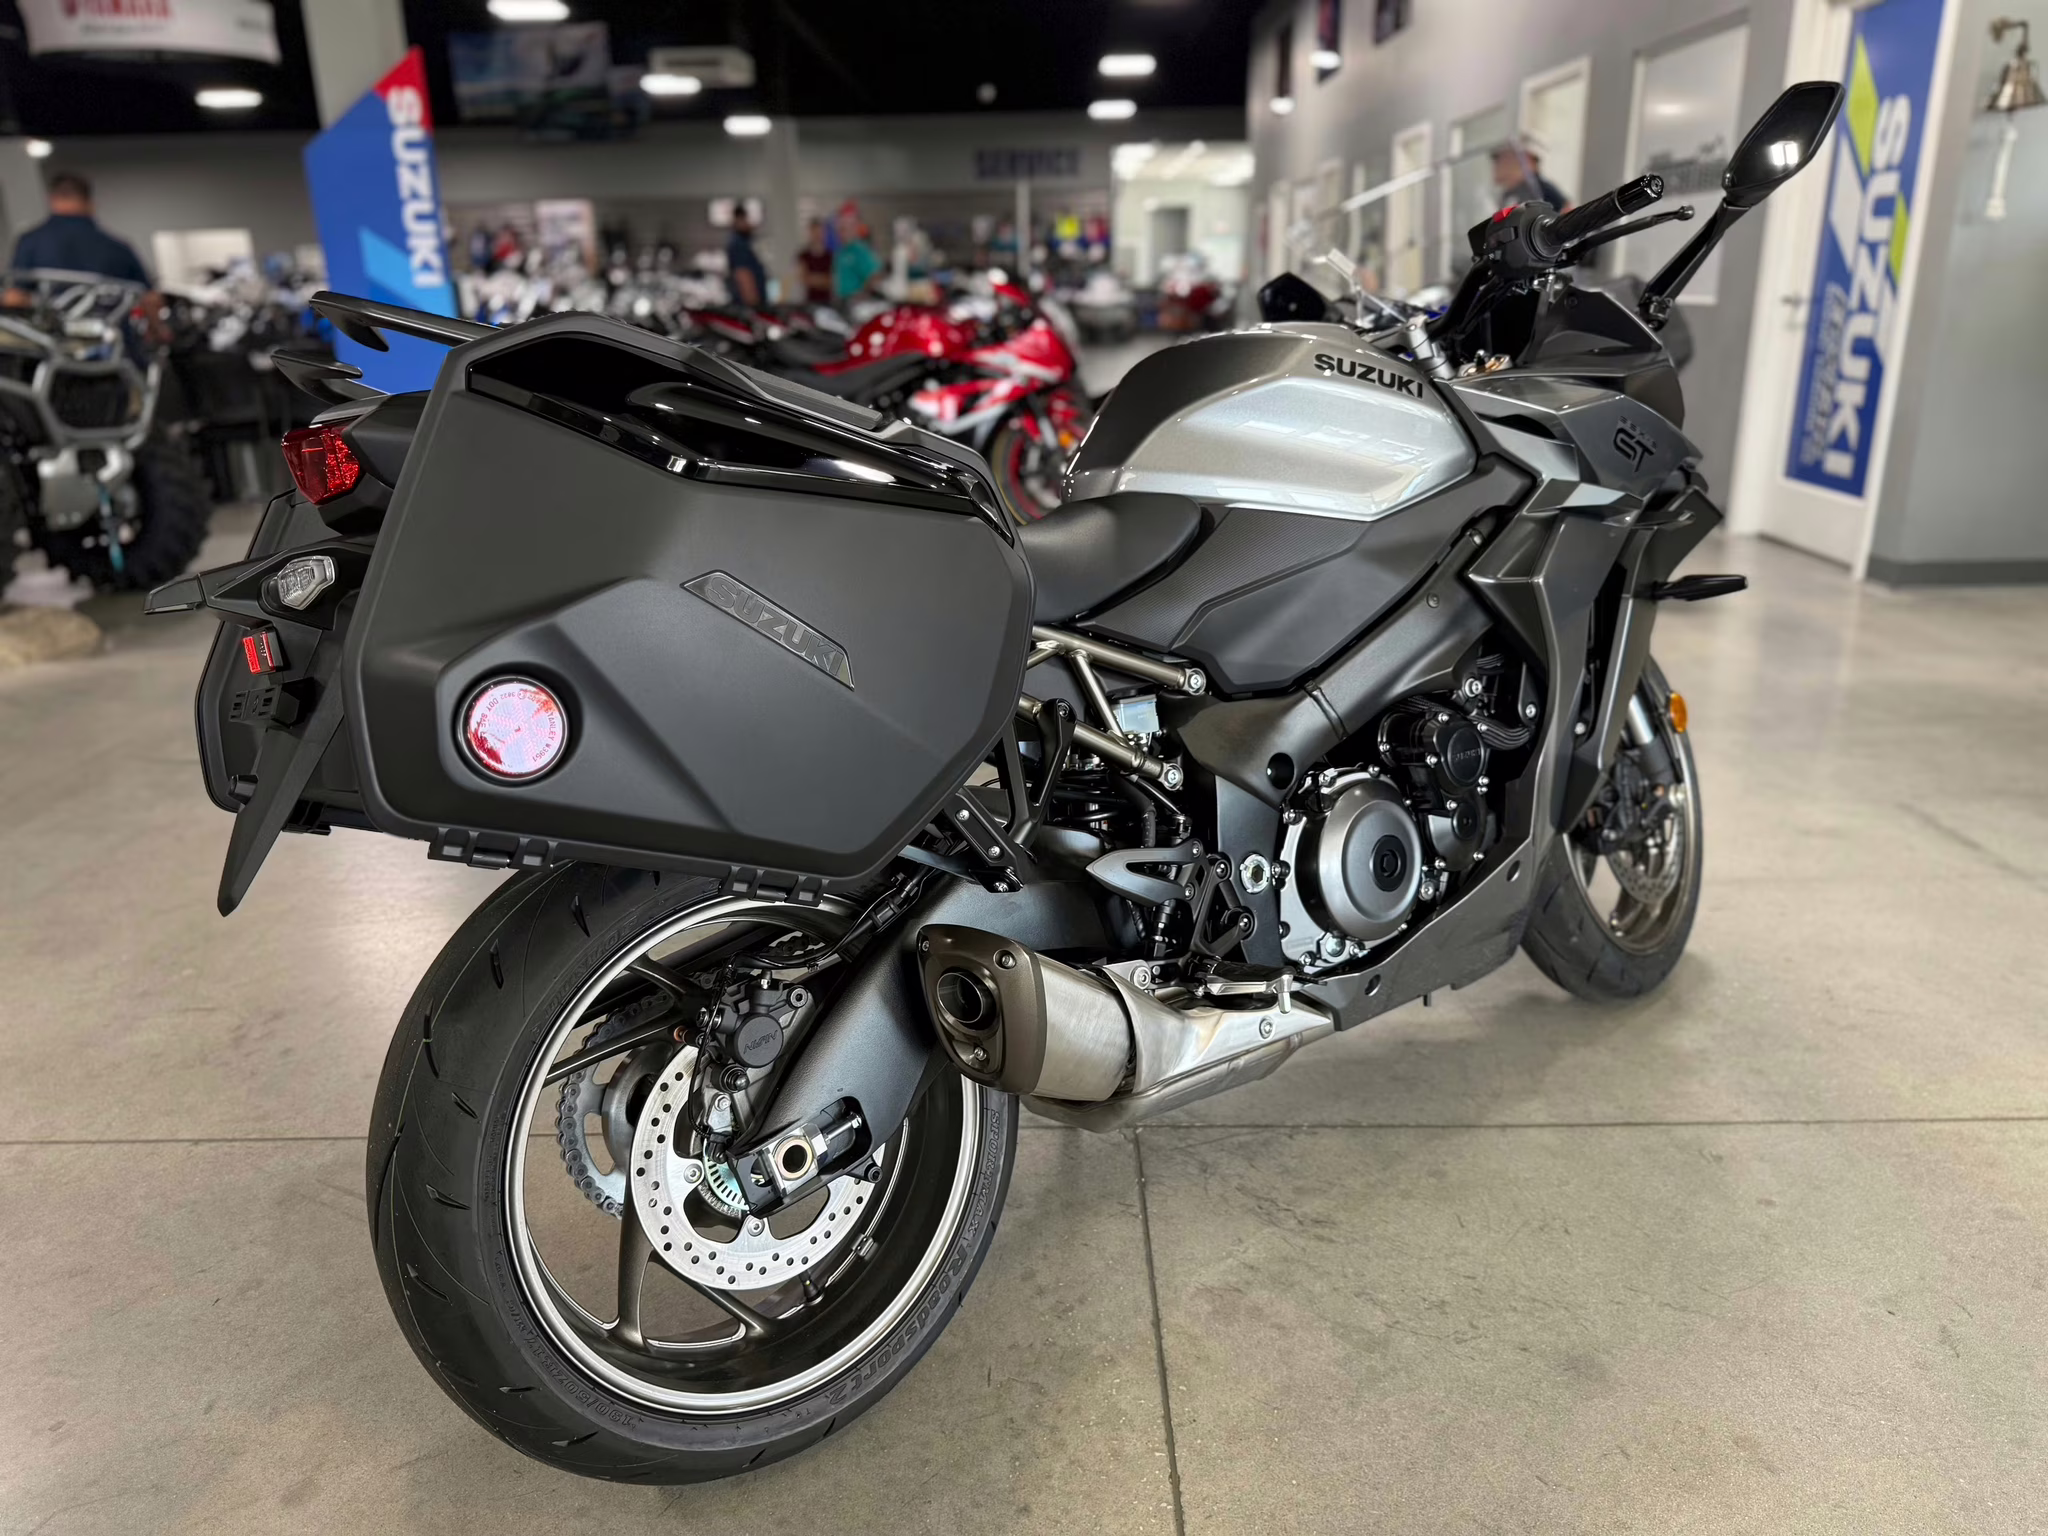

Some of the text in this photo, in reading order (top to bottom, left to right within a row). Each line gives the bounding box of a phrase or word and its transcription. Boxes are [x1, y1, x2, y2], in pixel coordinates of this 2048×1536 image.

[386, 86, 446, 288] SUZUKI
[1822, 94, 1912, 480] SUZUKI
[1314, 353, 1423, 399] SUZUKI
[706, 576, 845, 676] SUZUKI
[967, 1110, 1000, 1237] SPORTMAX
